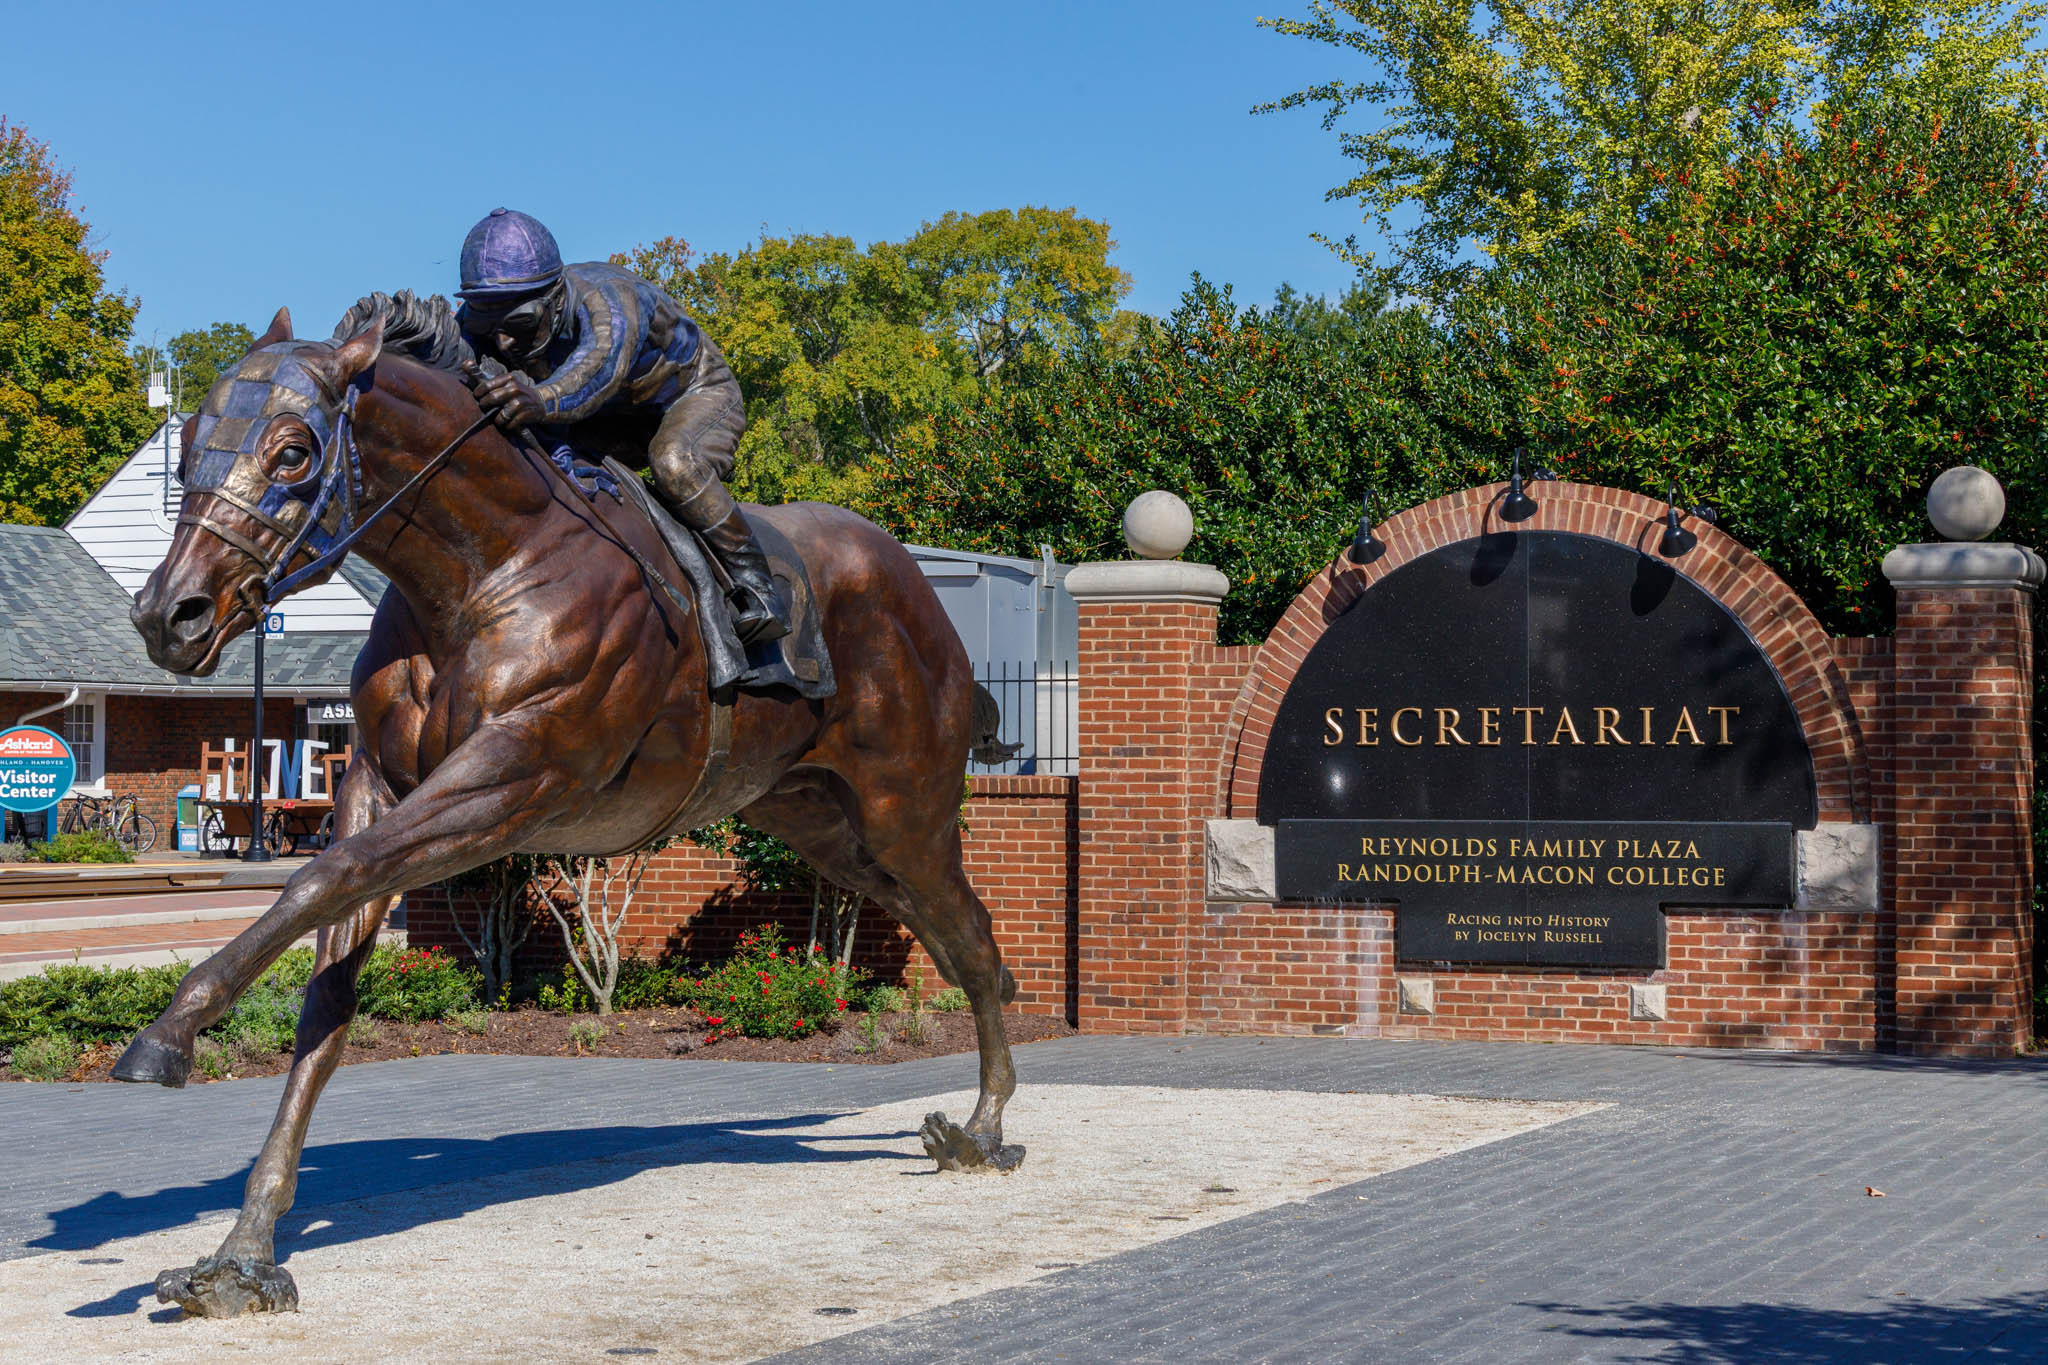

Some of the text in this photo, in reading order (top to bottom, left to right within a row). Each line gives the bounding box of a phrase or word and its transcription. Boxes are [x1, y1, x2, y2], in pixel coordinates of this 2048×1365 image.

[272, 617, 278, 629] E
[1323, 706, 1741, 747] SECRETARIAT
[1, 738, 53, 750] Ashland
[0, 769, 56, 784] Visitor
[224, 738, 330, 800] LOVE
[0, 784, 56, 798] Center
[1361, 837, 1702, 859] REYNOLDS FAMILY PLAZA
[1337, 863, 1726, 886] RANDOLPH-MACON COLLEGE
